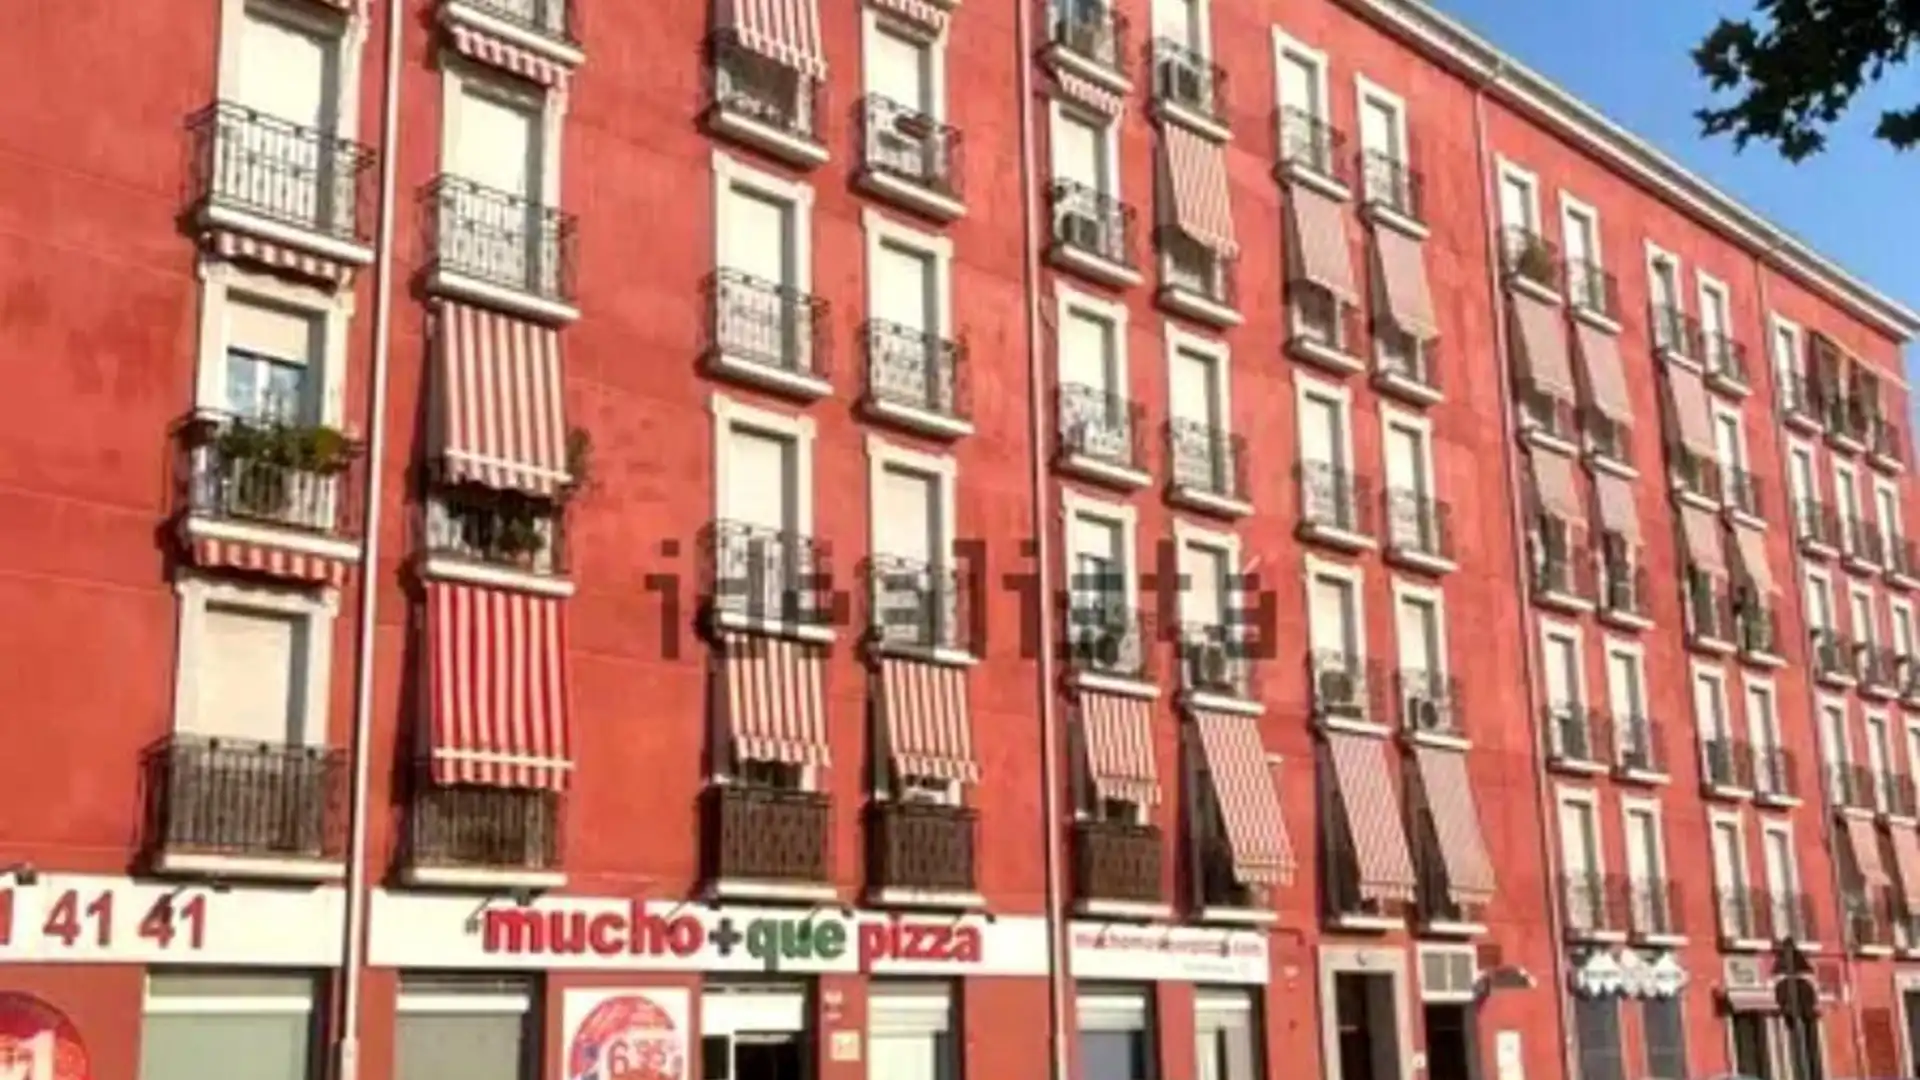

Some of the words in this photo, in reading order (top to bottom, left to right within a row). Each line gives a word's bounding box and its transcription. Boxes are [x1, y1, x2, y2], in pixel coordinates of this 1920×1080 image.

[43, 889, 113, 946] 41
[138, 893, 206, 949] 41
[858, 910, 982, 974] pizza
